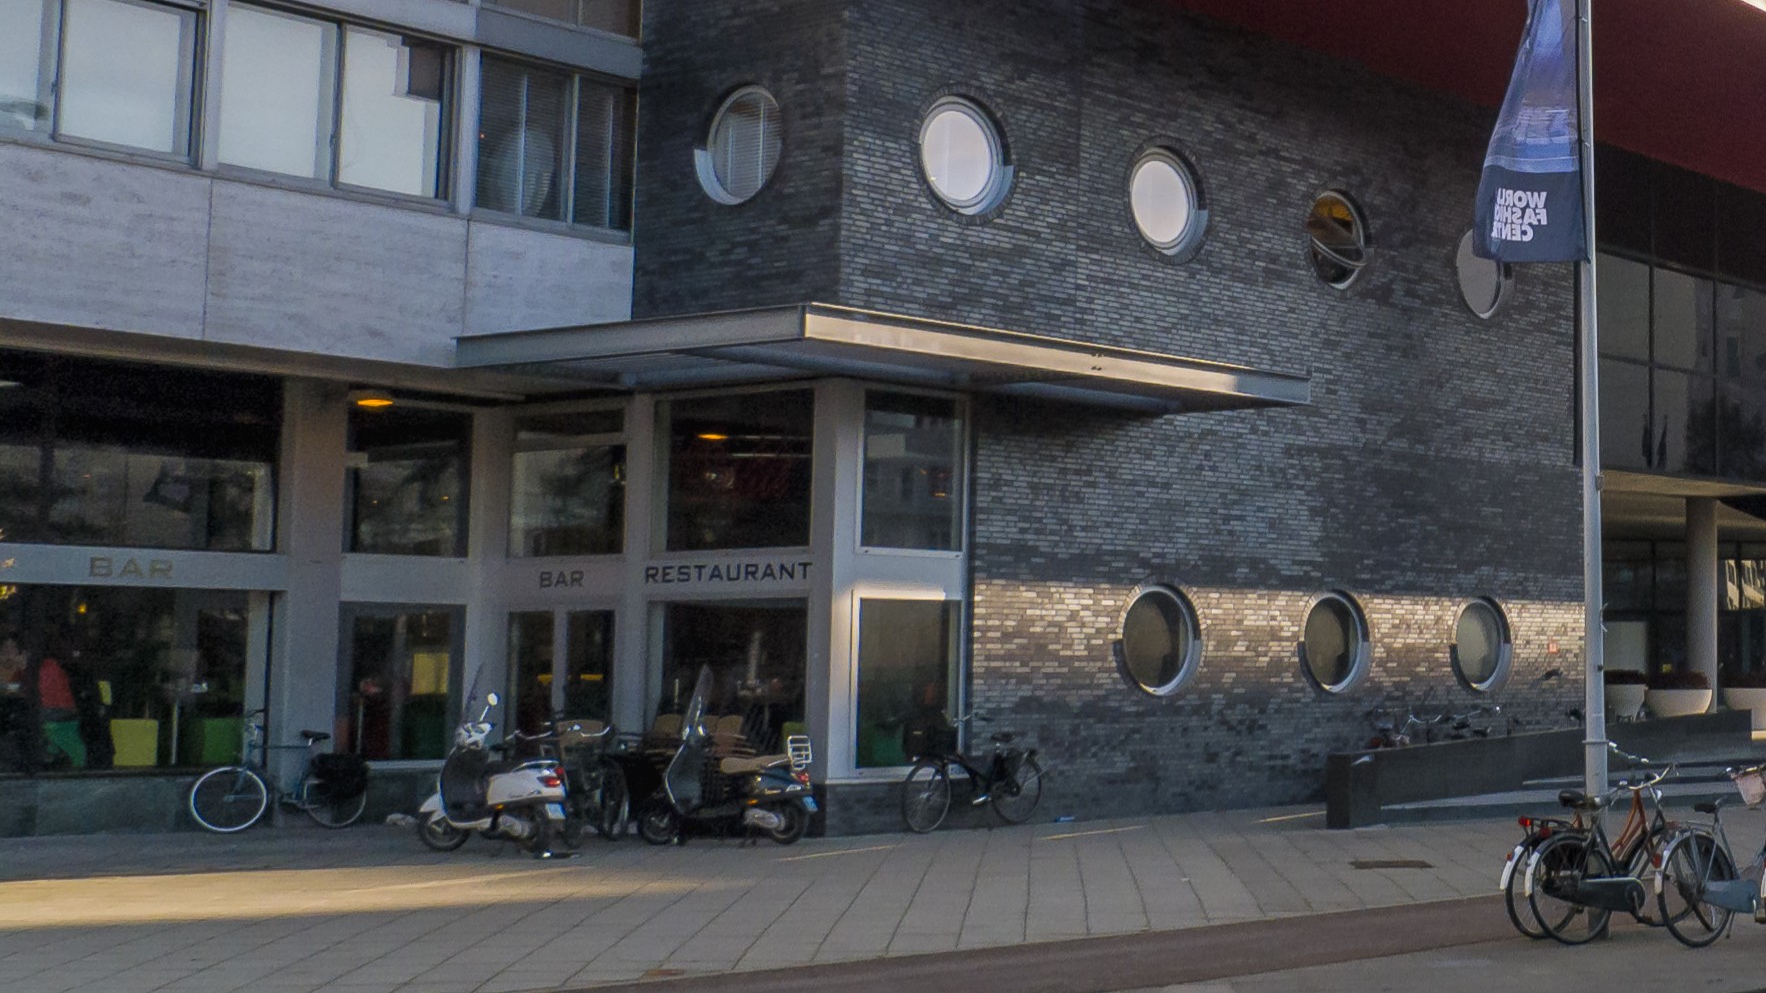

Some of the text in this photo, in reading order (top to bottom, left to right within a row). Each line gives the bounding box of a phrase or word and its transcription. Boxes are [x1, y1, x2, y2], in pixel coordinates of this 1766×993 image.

[88, 557, 174, 580] BAR
[539, 570, 585, 588] BAR
[644, 562, 813, 584] RESTAURANT
